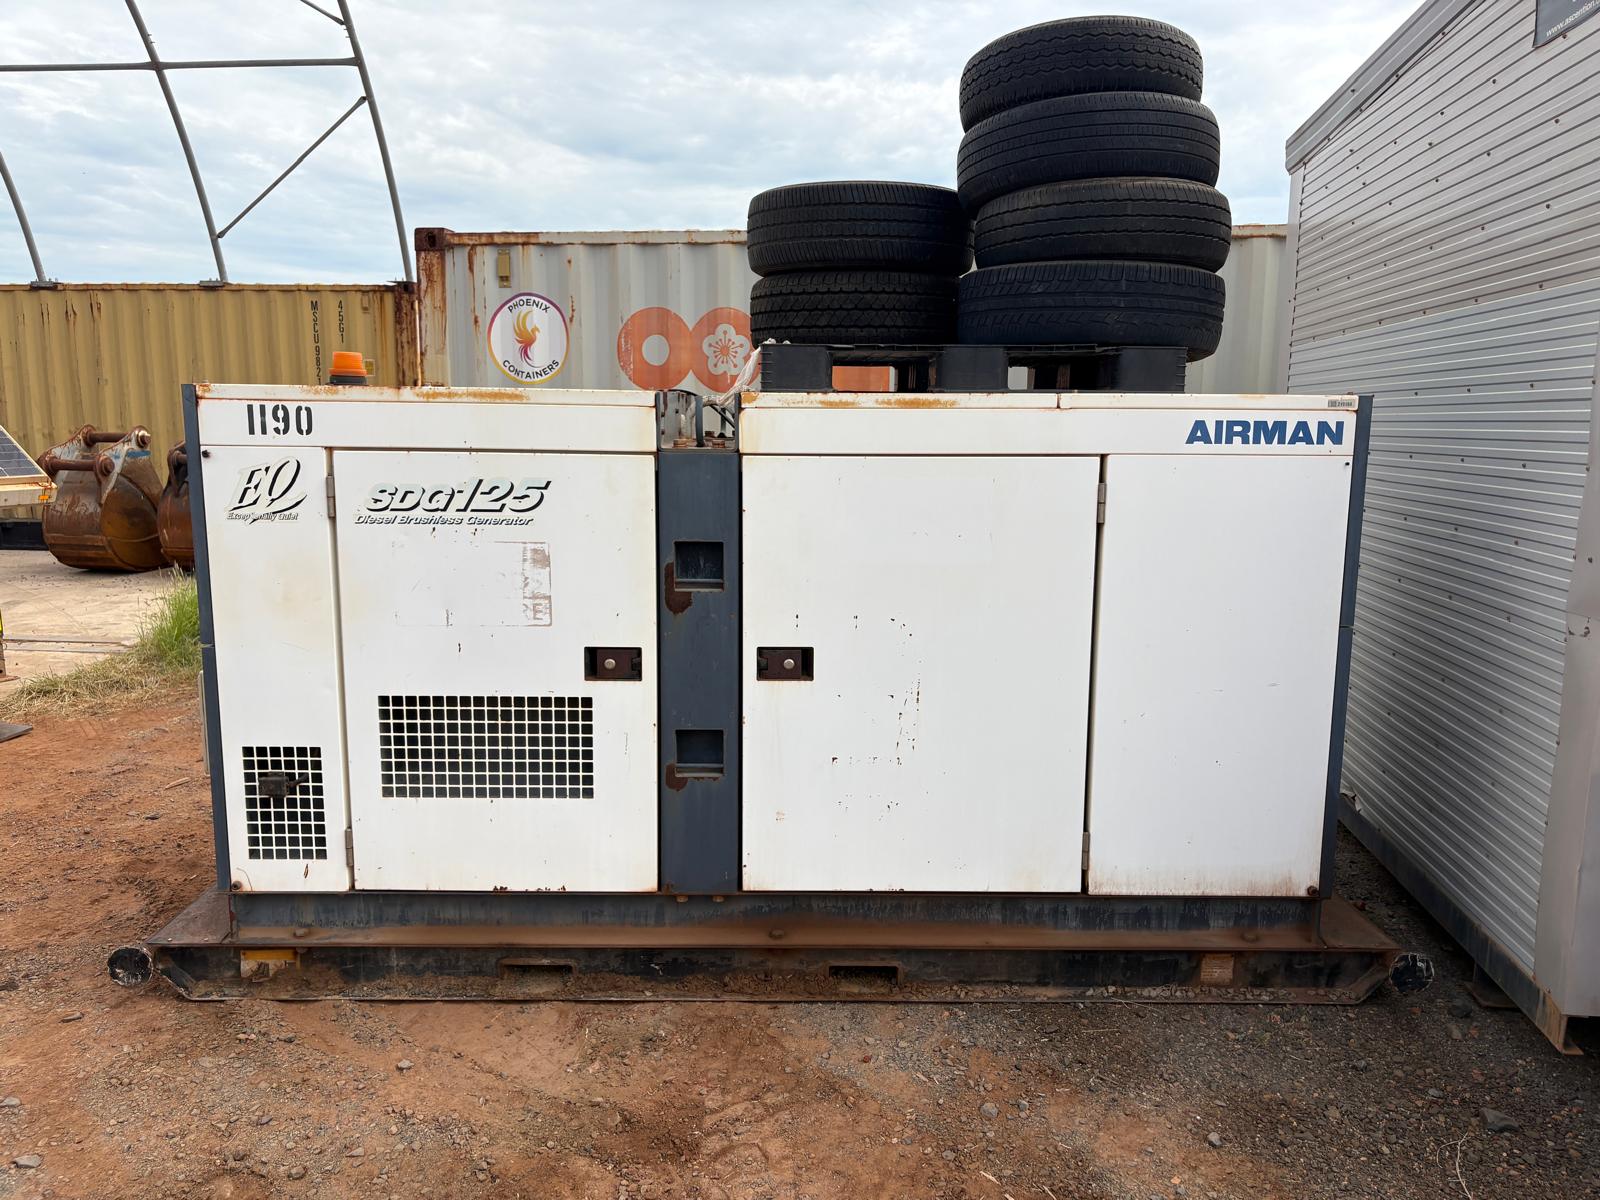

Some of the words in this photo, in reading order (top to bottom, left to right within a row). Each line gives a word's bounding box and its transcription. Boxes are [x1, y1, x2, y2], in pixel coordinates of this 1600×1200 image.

[507, 298, 551, 313] PHOENIX
[502, 359, 560, 380] CONTAINERS
[246, 403, 313, 436] 1190
[1185, 419, 1345, 446] AIRMAN
[354, 515, 397, 525] Diesel
[398, 515, 463, 525] Brushless
[466, 516, 534, 526] Generator
